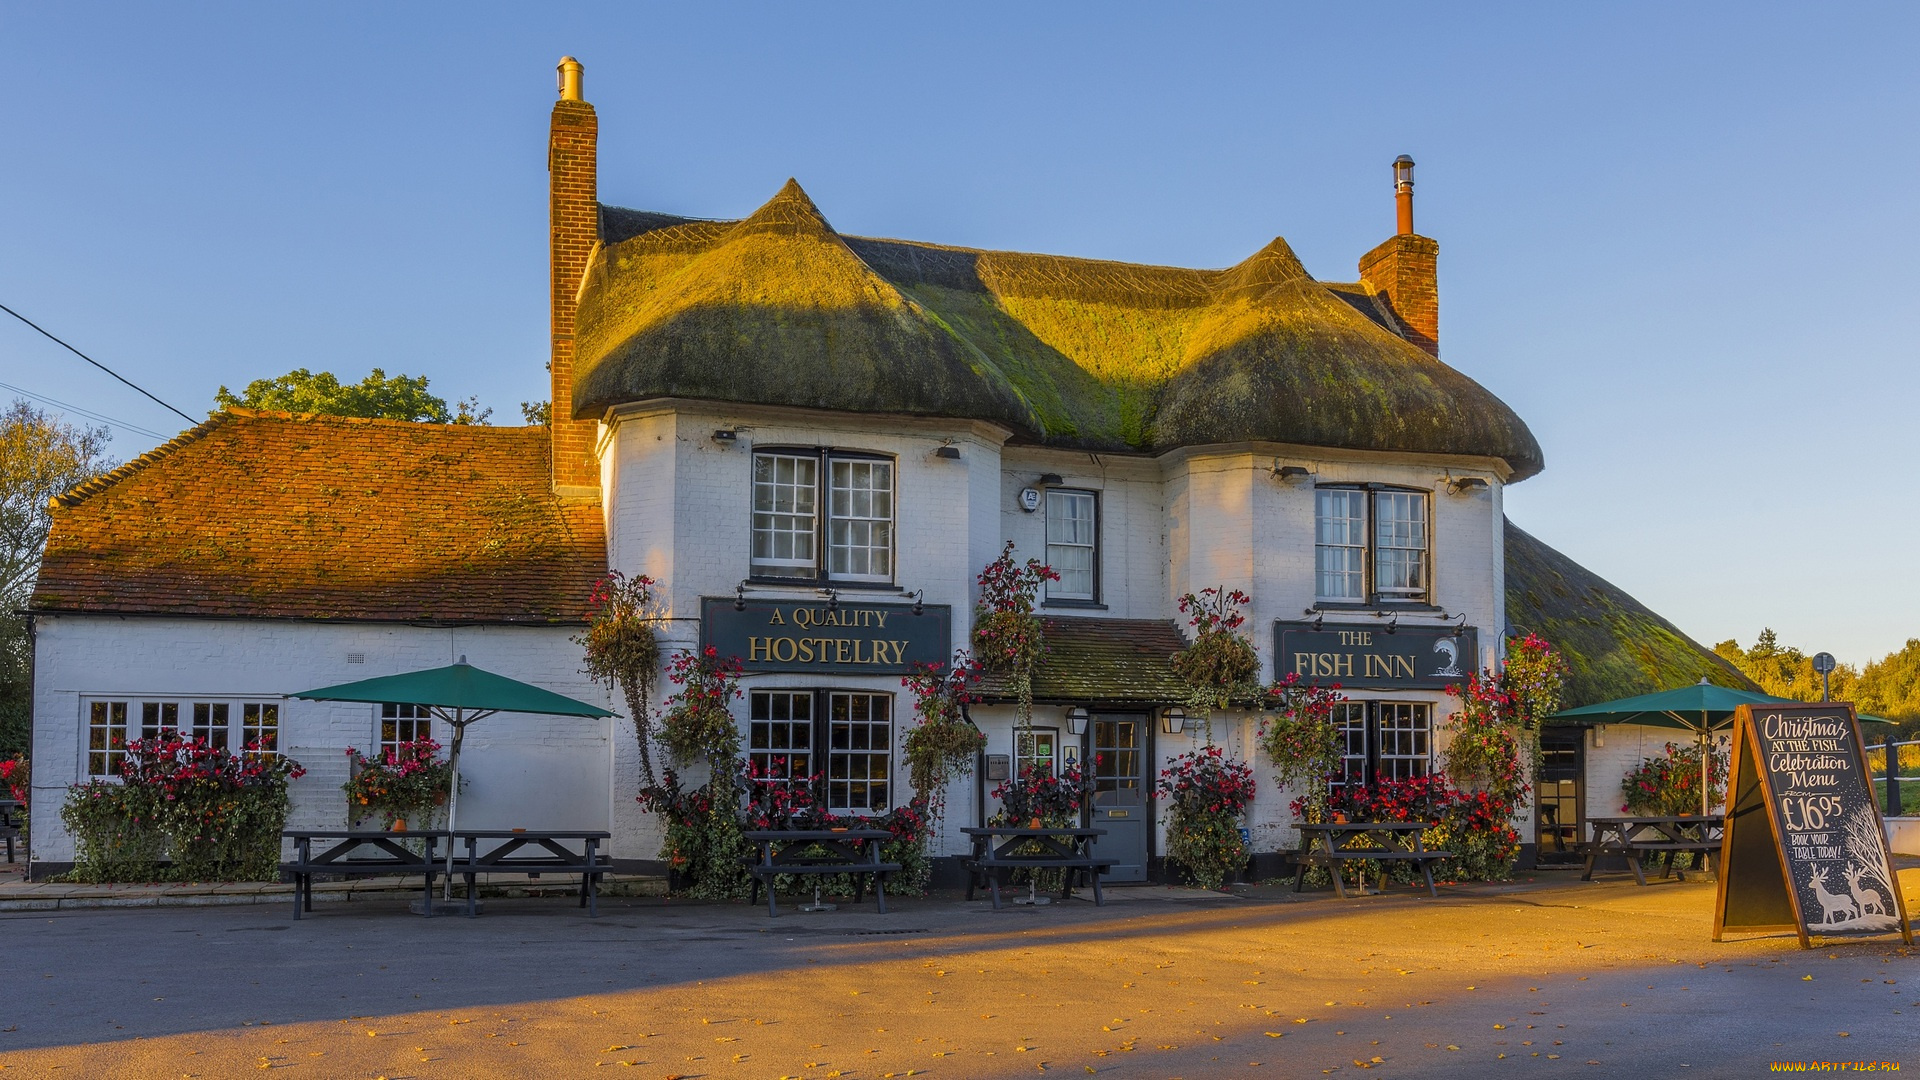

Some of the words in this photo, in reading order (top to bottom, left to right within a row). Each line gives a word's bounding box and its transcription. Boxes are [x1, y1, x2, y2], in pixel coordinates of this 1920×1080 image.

[769, 608, 786, 625] A
[792, 608, 889, 630] QUALITY
[1338, 631, 1373, 646] THE
[748, 637, 910, 665] HOSTELRY
[1294, 653, 1354, 677] FISH
[1364, 654, 1417, 679] INN
[1764, 714, 1850, 741] Christmas
[1771, 740, 1785, 752] AT
[1786, 740, 1810, 752] THE
[1770, 753, 1850, 773] Celebration
[1786, 771, 1840, 790] Menu
[1784, 790, 1814, 798] FROM
[1791, 834, 1810, 846] BOOK
[1810, 833, 1829, 845] YOUR
[1793, 846, 1816, 859] TABLE
[1816, 845, 1842, 859] TODAY!
